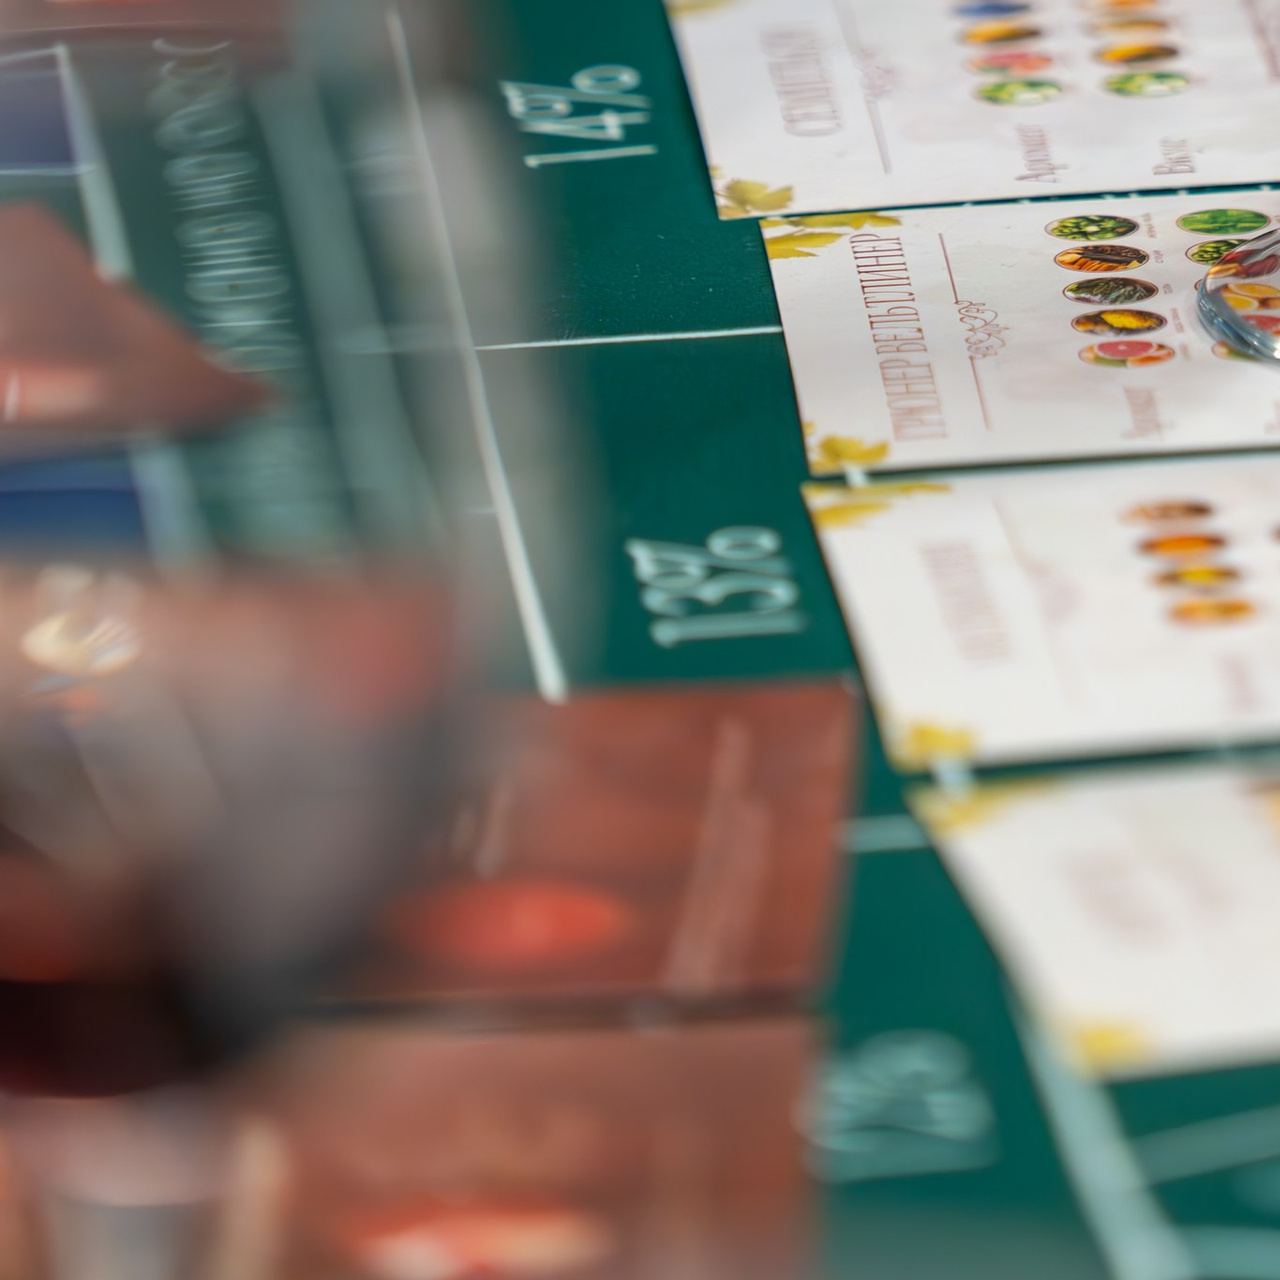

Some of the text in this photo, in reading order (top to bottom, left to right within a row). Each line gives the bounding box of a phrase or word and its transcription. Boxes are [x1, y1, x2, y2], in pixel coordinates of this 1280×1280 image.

[500, 63, 657, 168] 14%
[849, 232, 947, 439] ГРЮНЕР ВЕЛЬТЛИНЕР
[624, 525, 807, 647] 13%
